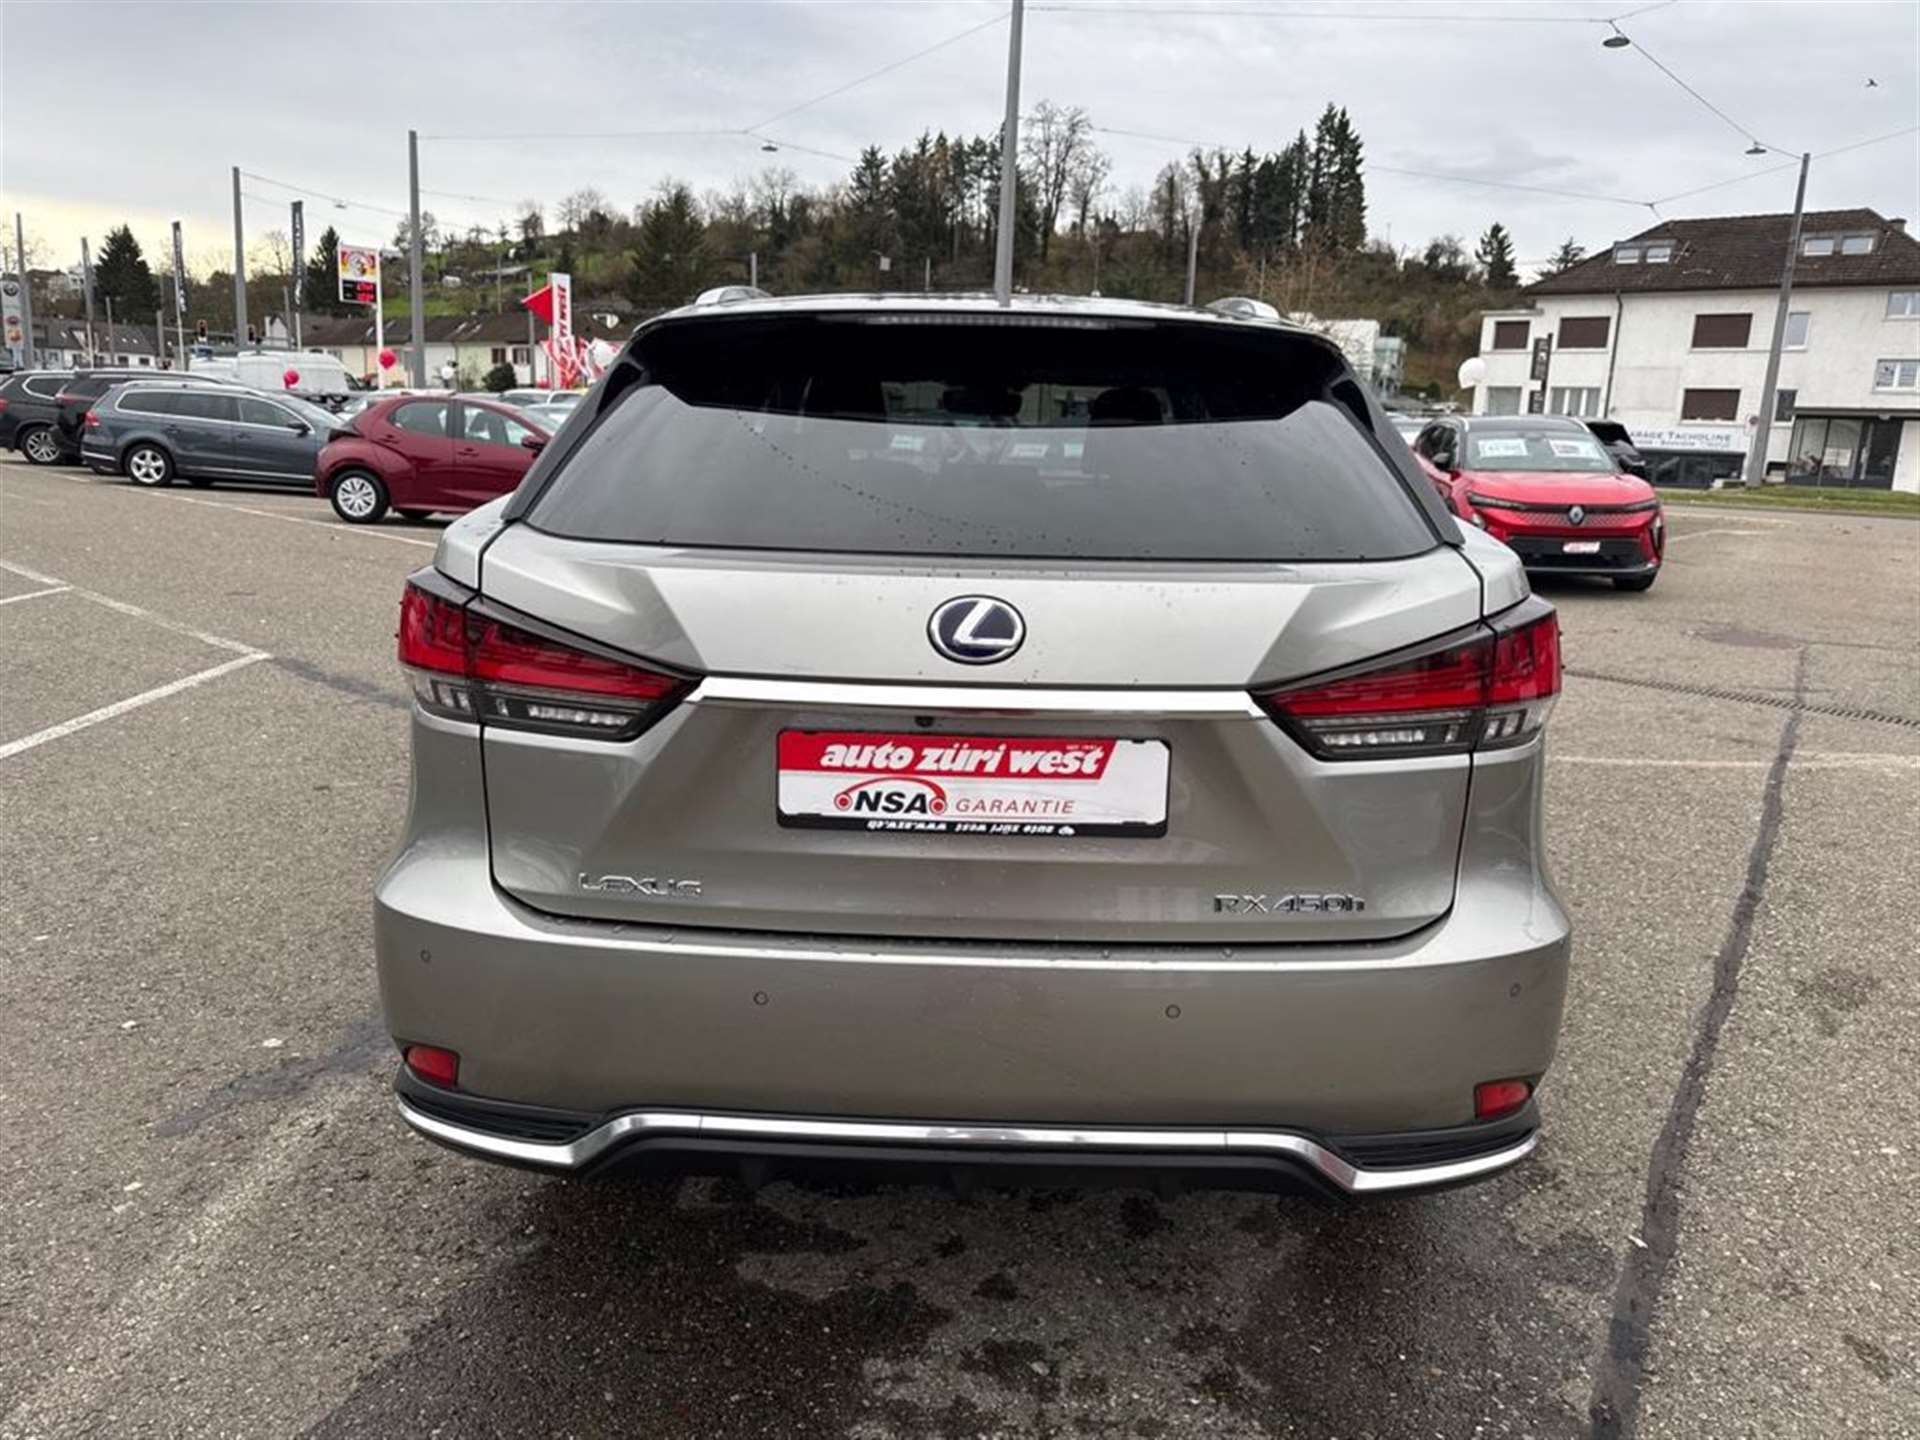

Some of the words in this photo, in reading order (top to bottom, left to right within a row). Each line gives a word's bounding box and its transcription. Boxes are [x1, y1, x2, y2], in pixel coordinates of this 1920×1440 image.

[820, 741, 914, 769] auto
[915, 742, 1006, 773] züri
[1009, 746, 1104, 775] west
[854, 790, 928, 814] NSA
[956, 798, 1075, 814] GARANTIE
[579, 872, 702, 895] LEXUS
[1213, 893, 1269, 913] RX
[1272, 893, 1366, 912] 450h
